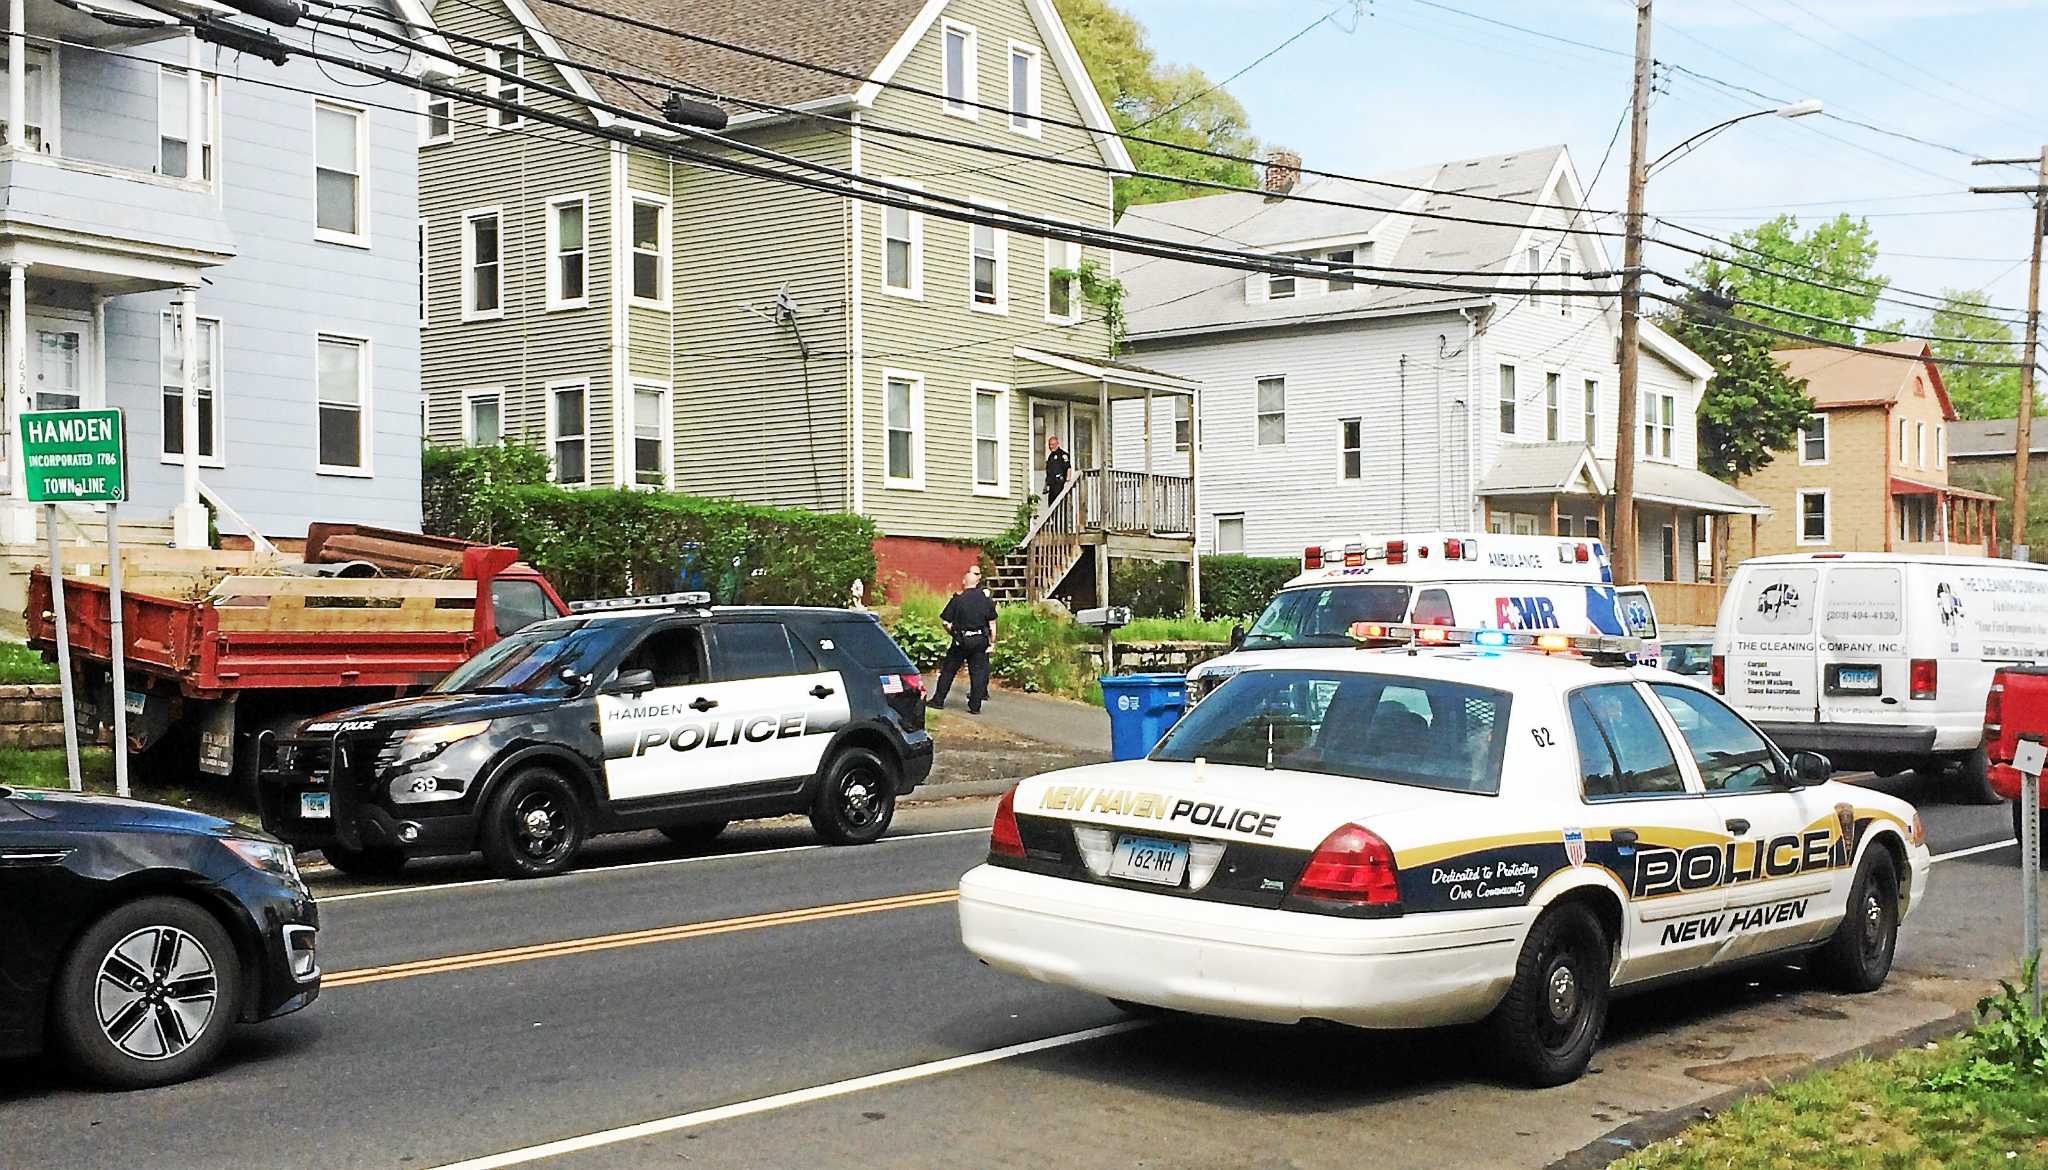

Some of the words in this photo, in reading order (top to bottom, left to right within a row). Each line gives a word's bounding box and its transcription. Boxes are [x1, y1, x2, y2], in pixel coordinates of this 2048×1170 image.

[28, 418, 112, 443] HAMDEN
[29, 454, 93, 467] INCORPORATED
[97, 453, 117, 465] 1786
[44, 478, 75, 494] TOWN
[81, 478, 106, 494] LINE
[1489, 553, 1543, 568] AMBULANCE
[1495, 597, 1560, 630] AMR
[1737, 641, 1757, 651] THE
[1760, 641, 1814, 651] CLEANING
[1820, 642, 1876, 653] COMPANY,
[609, 704, 683, 721] HAMDEN
[340, 720, 378, 732] POLICE
[636, 712, 806, 757] POLICE
[1531, 727, 1555, 747] 62
[413, 777, 438, 792] 39
[1039, 786, 1094, 812] NEW
[1090, 788, 1171, 820] HAVEN
[1170, 799, 1281, 838] POLICE
[1431, 868, 1480, 884] Dedicated
[1482, 866, 1493, 879] to
[1497, 861, 1539, 878] Protecting
[1632, 830, 1831, 898] POLICE
[1450, 884, 1472, 900] Our
[1477, 881, 1526, 897] Community
[1661, 914, 1725, 946] NEW
[1728, 899, 1809, 932] HAVEN
